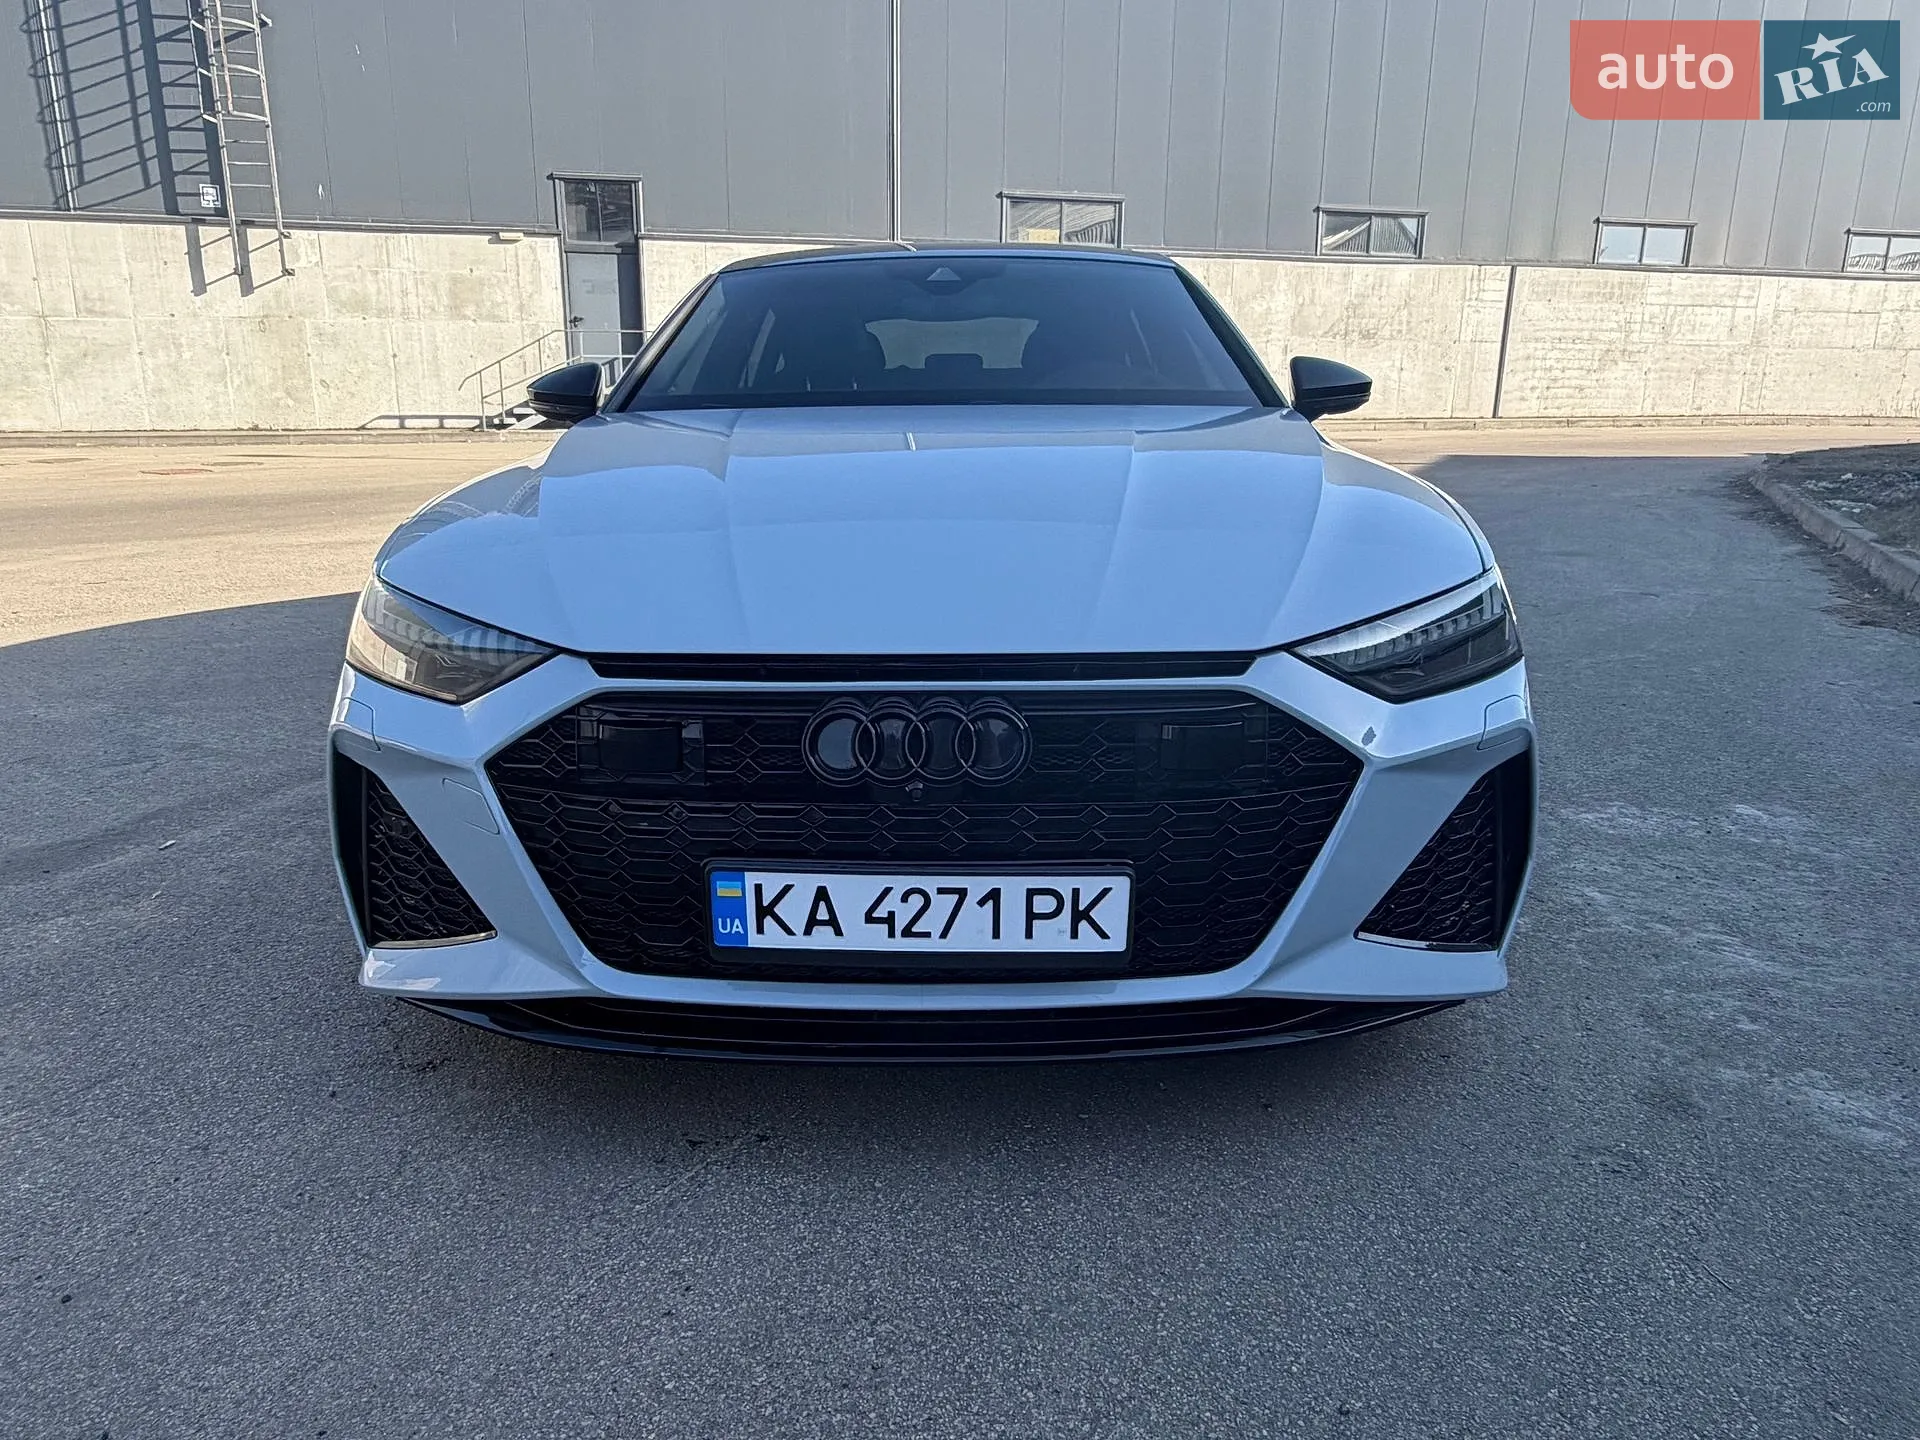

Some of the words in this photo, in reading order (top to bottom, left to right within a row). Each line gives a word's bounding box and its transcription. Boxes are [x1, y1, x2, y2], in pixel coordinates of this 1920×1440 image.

[717, 917, 745, 936] UA
[753, 883, 845, 938] KA
[864, 886, 1002, 941] 4271
[1025, 886, 1113, 941] PK
